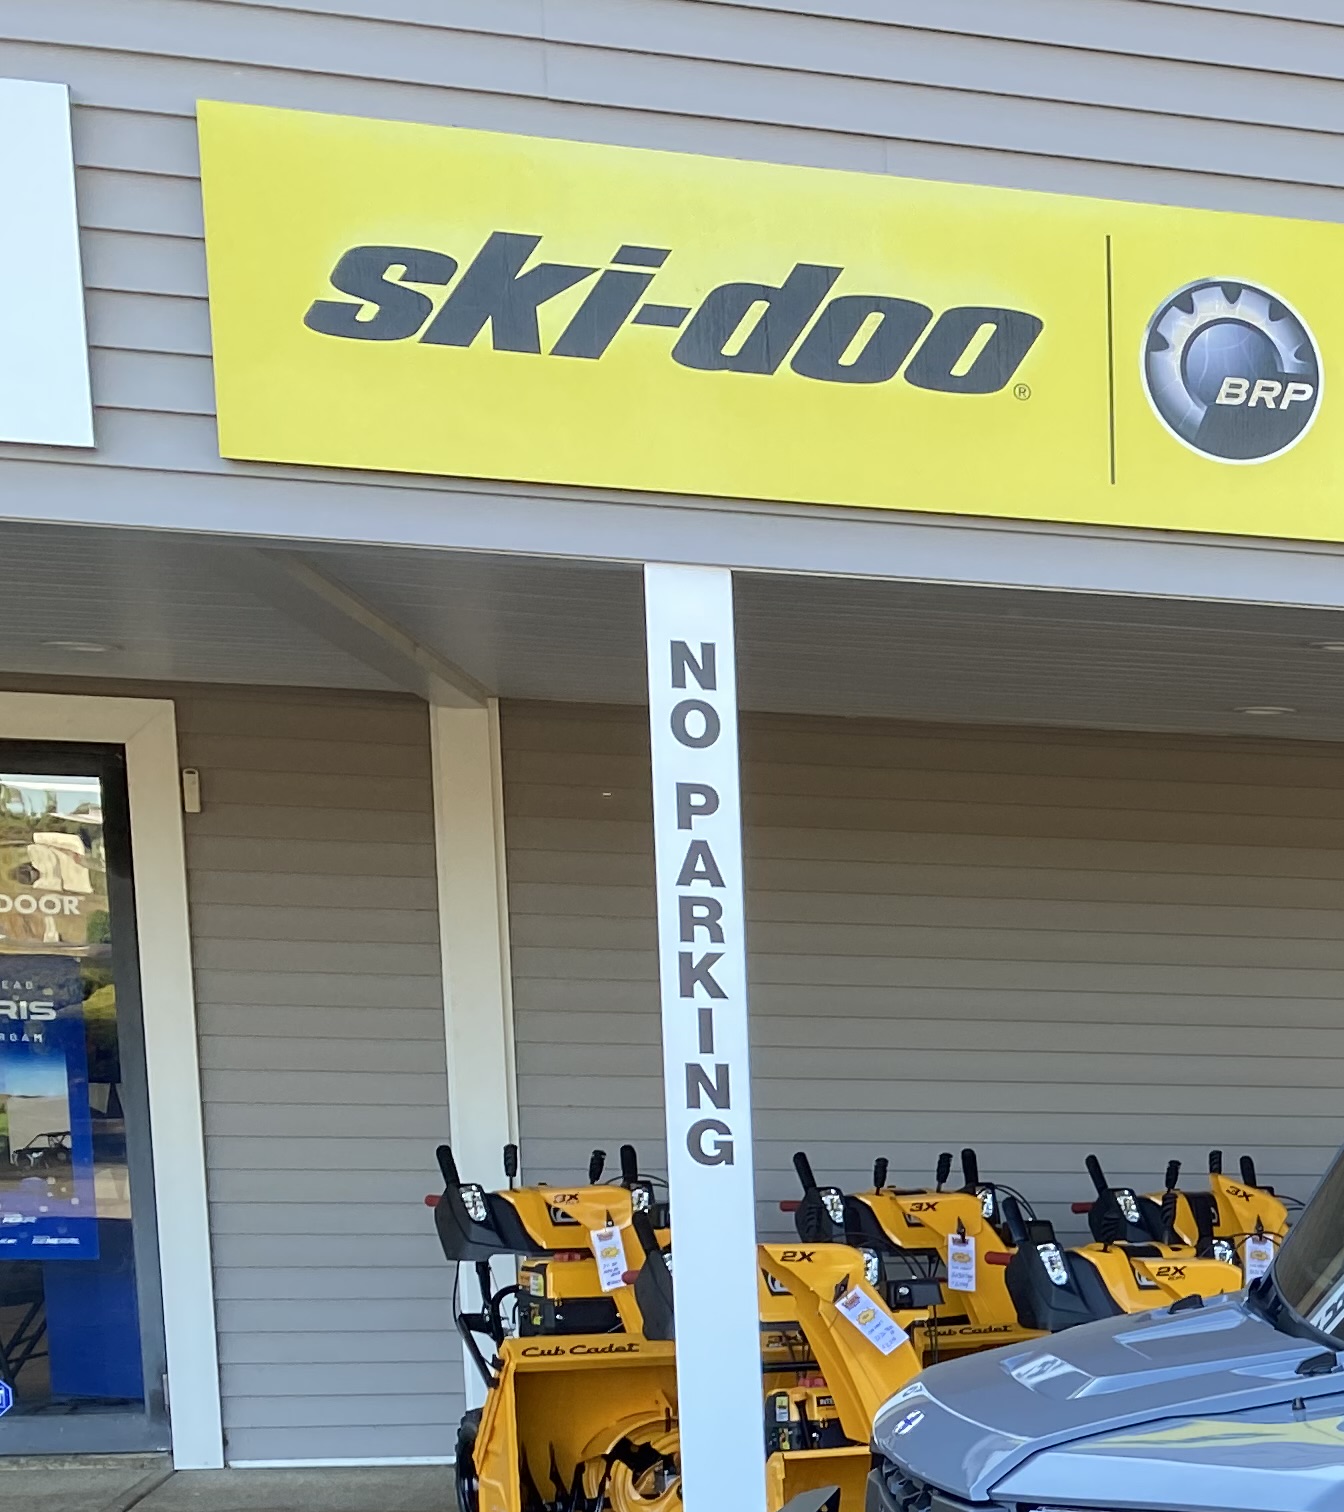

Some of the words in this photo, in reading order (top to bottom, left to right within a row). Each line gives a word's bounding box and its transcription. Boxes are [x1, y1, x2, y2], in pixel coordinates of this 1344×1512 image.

[304, 231, 1044, 396] ski-doo
[1214, 374, 1315, 411] BRP
[670, 639, 721, 749] NO
[675, 781, 736, 1167] PARKING
[1225, 1185, 1255, 1202] 3X
[910, 1201, 940, 1212] 3X
[780, 1250, 816, 1263] 2X
[1156, 1265, 1188, 1277] 2X
[959, 1324, 1014, 1336] Cadet
[521, 1345, 566, 1358] Cub
[569, 1342, 640, 1355] Cadet
